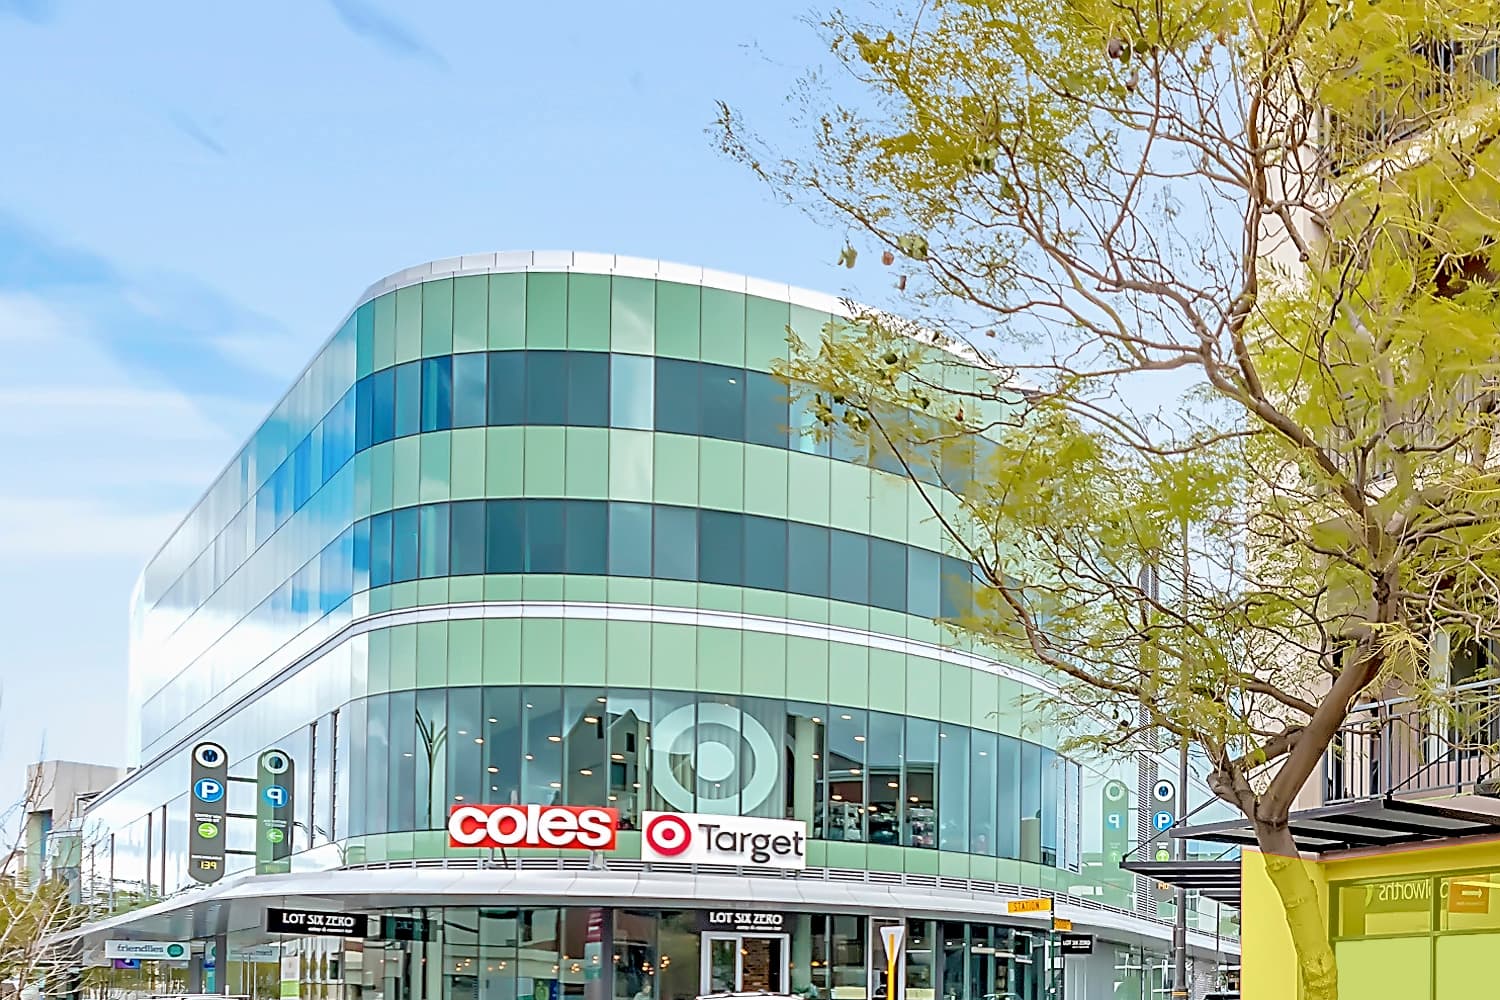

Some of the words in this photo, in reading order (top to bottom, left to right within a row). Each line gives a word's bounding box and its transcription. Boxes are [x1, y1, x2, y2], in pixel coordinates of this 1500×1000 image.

[201, 782, 220, 799] P
[448, 804, 615, 847] coles
[1158, 813, 1171, 829] P
[698, 823, 804, 863] Target
[282, 912, 306, 925] LOT
[306, 914, 324, 926] SIX
[325, 915, 355, 927] ZERO
[709, 911, 734, 924] LOT
[734, 912, 752, 924] SIX
[752, 913, 783, 925] ZERO
